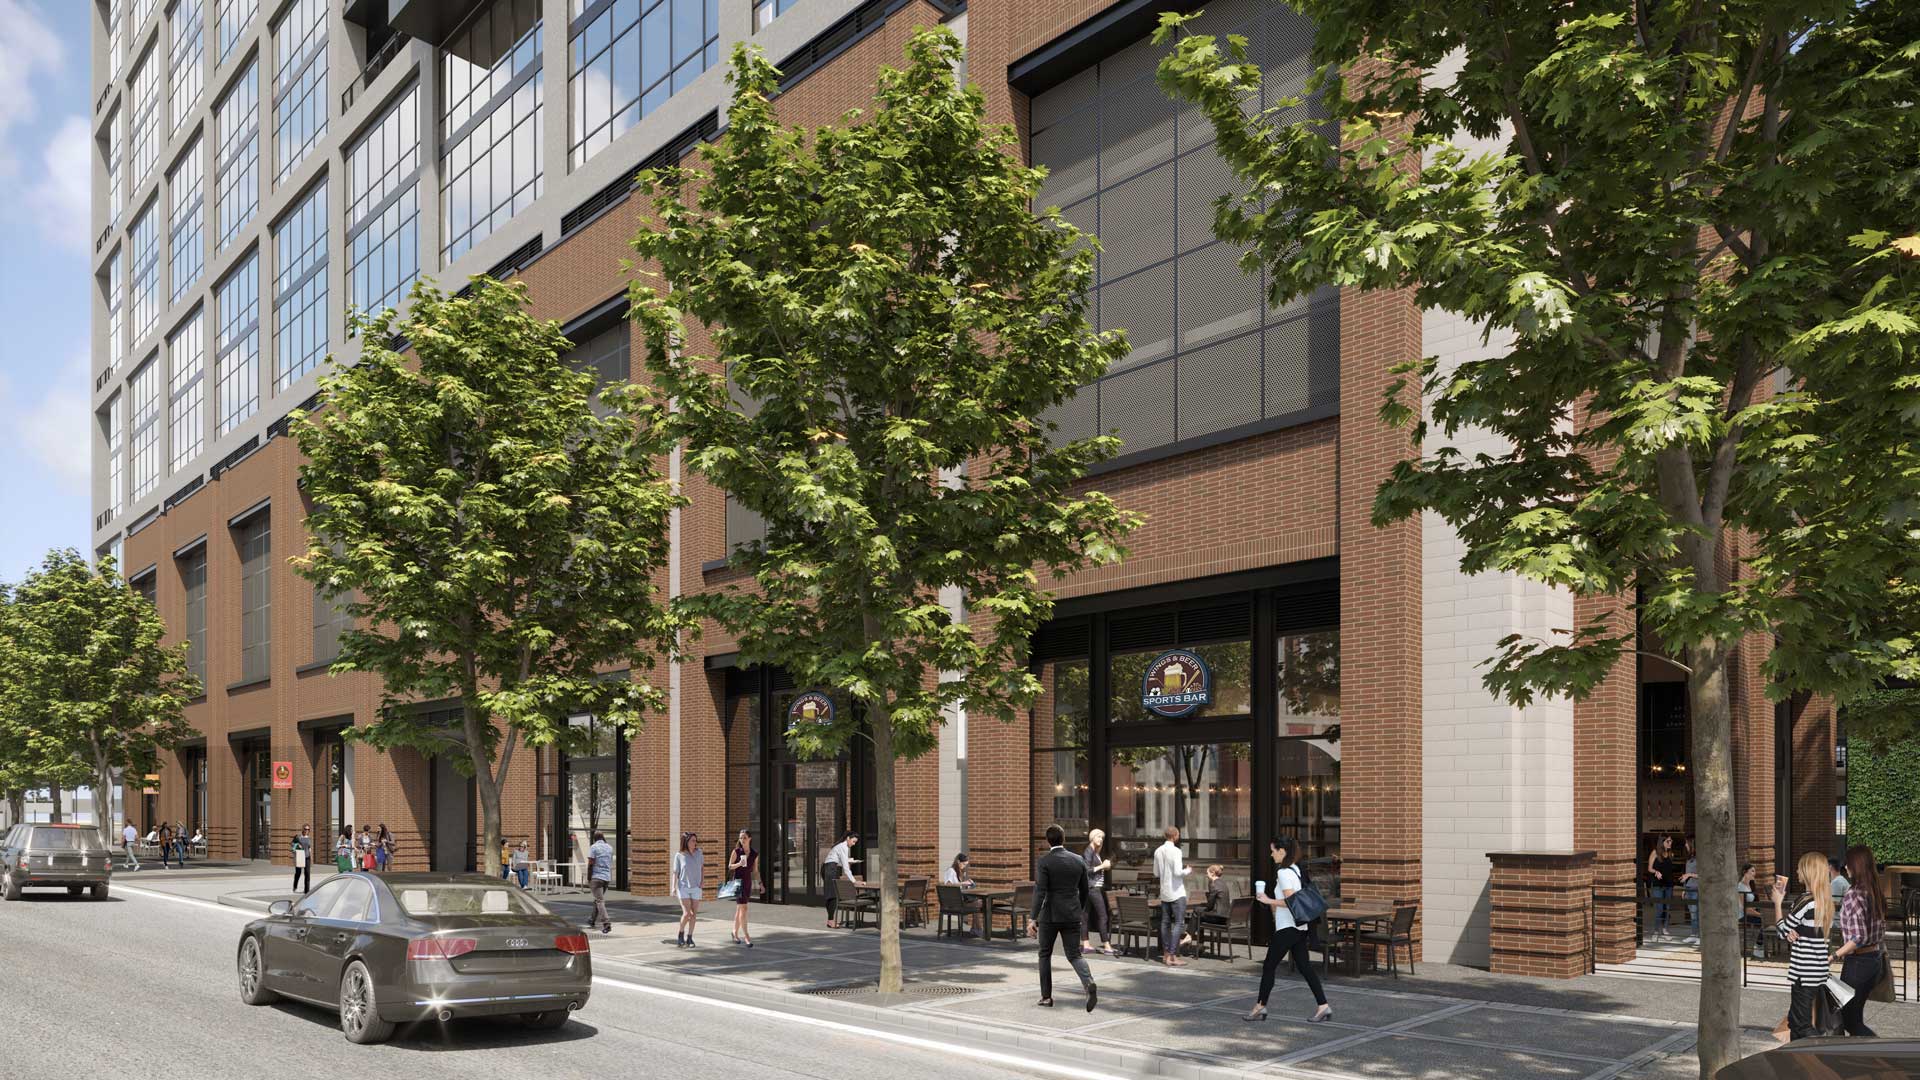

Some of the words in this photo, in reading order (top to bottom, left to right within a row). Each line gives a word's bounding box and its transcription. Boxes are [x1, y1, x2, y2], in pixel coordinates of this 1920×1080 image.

[1149, 656, 1172, 677] WINGS
[1179, 655, 1199, 671] BEER
[1143, 695, 1182, 705] SPORTS
[1183, 693, 1207, 702] BAR
